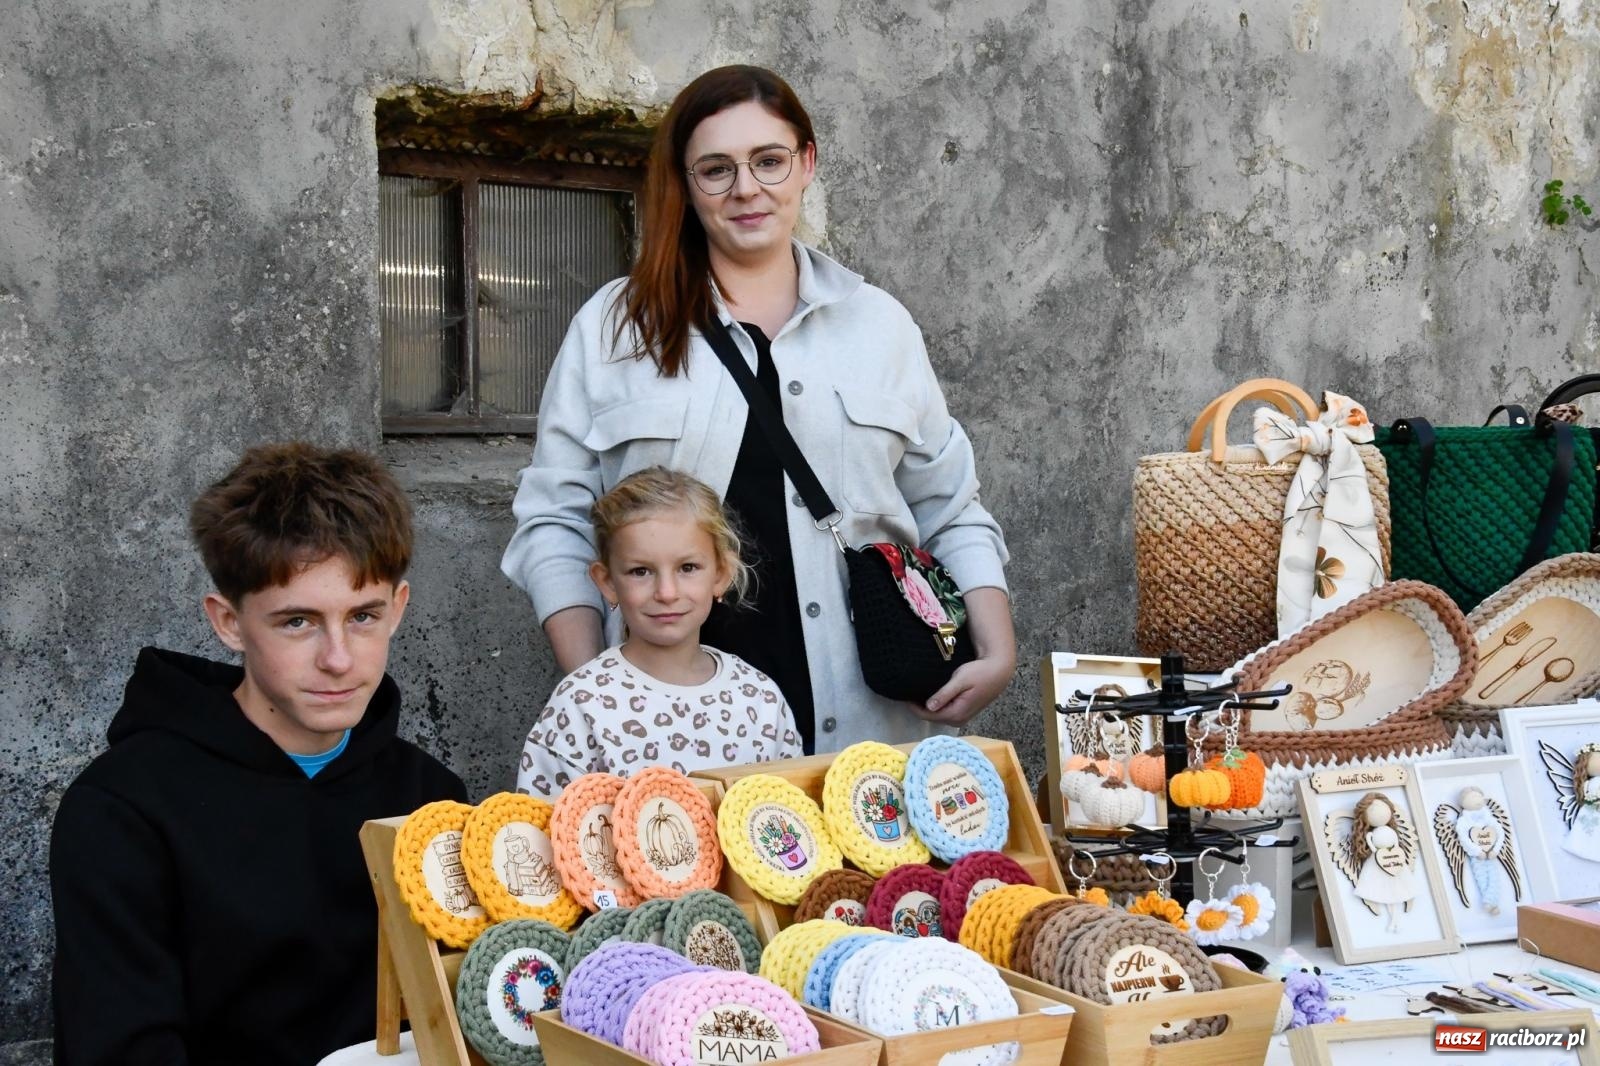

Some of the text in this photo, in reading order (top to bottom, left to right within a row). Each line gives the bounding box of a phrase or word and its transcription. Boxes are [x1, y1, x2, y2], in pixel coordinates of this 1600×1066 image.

[1361, 772, 1385, 784] Stróż
[597, 895, 610, 908] 15
[1114, 950, 1157, 978] Ale
[1110, 976, 1157, 993] NAJPIERW
[934, 1003, 960, 1027] M
[698, 1039, 777, 1063] MAMA
